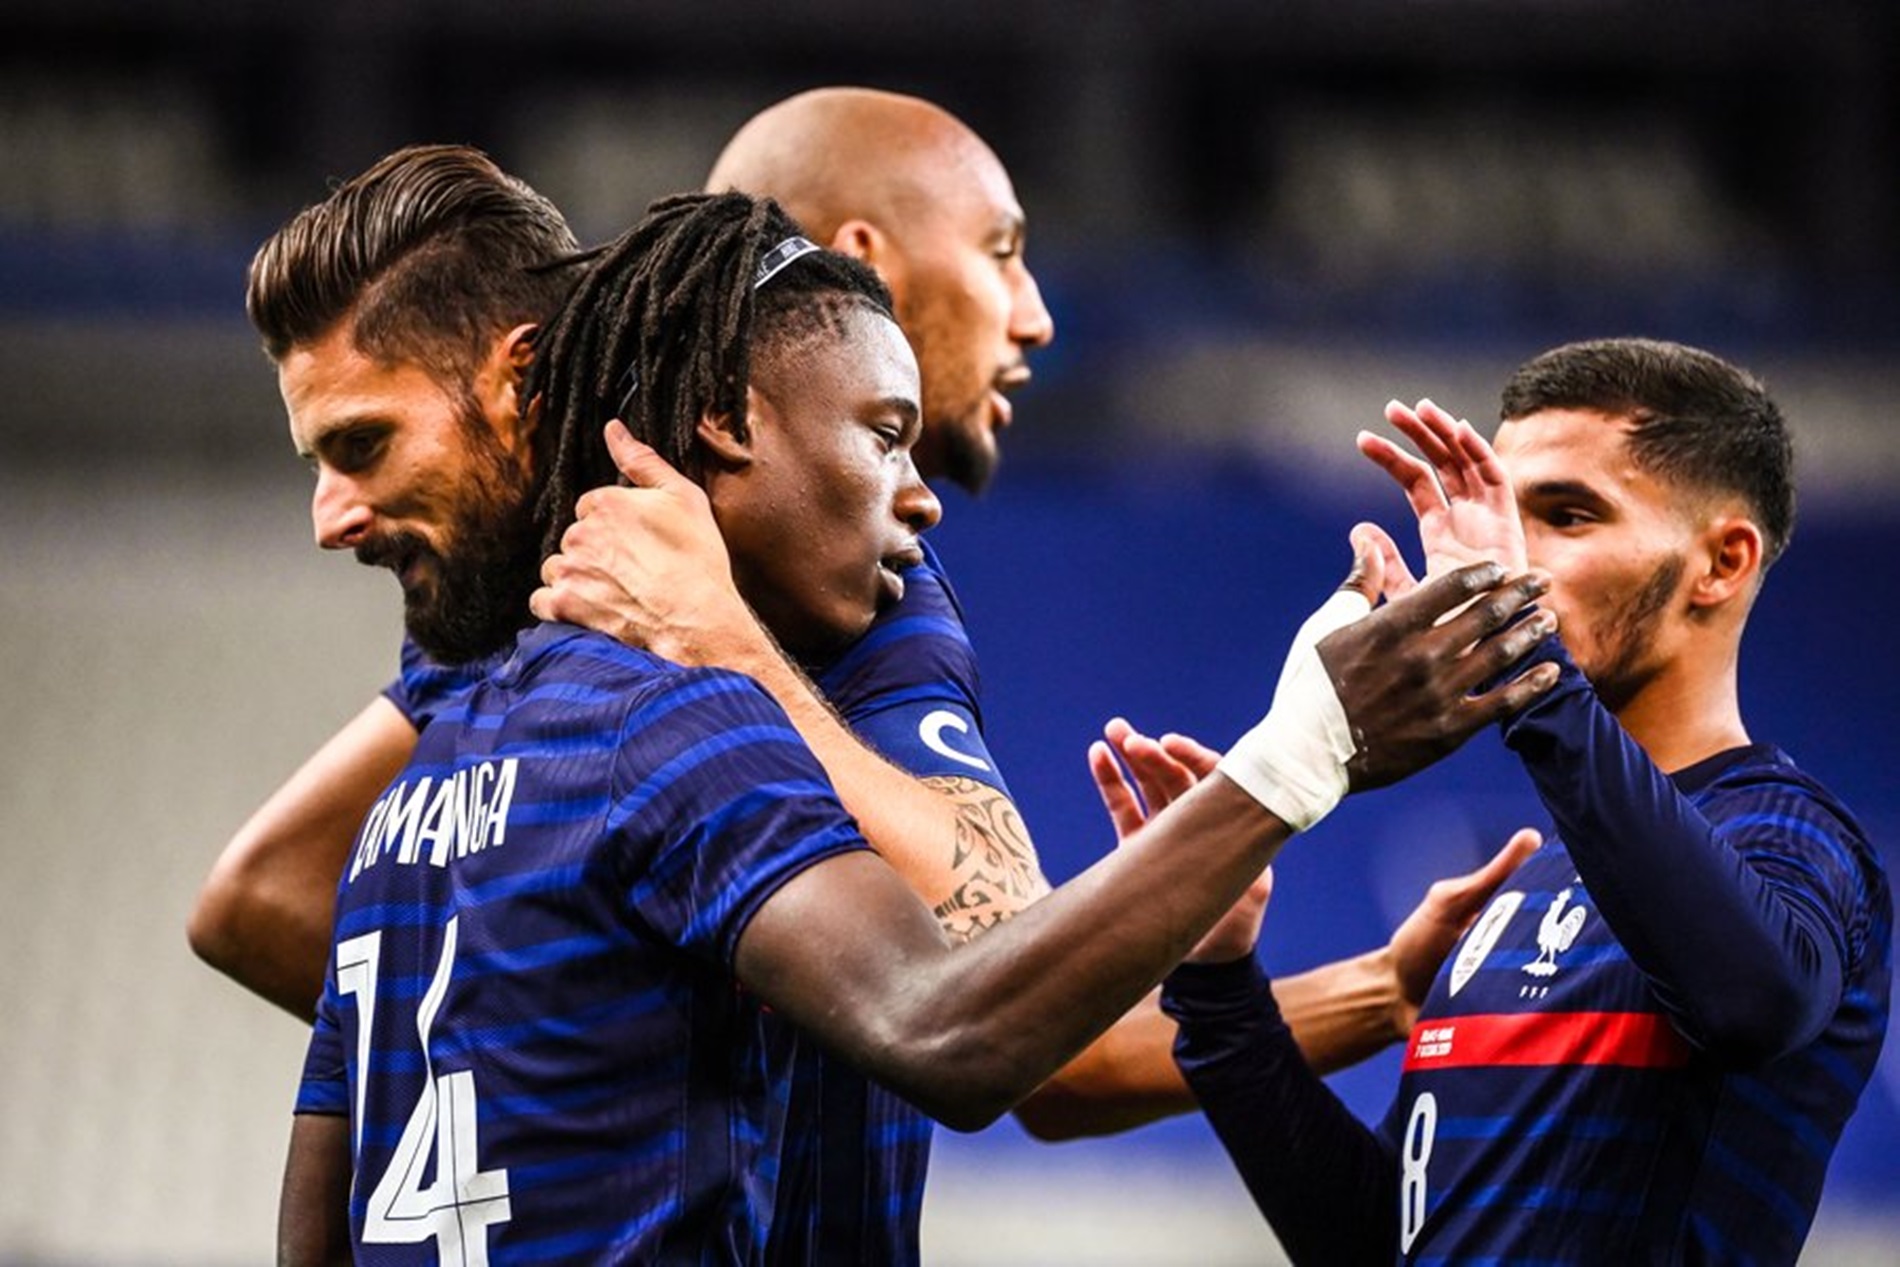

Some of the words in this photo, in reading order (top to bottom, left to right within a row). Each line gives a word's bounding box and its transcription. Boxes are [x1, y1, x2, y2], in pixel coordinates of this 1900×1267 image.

[918, 710, 991, 771] C
[336, 915, 512, 1267] 14
[1402, 1091, 1438, 1255] 8
